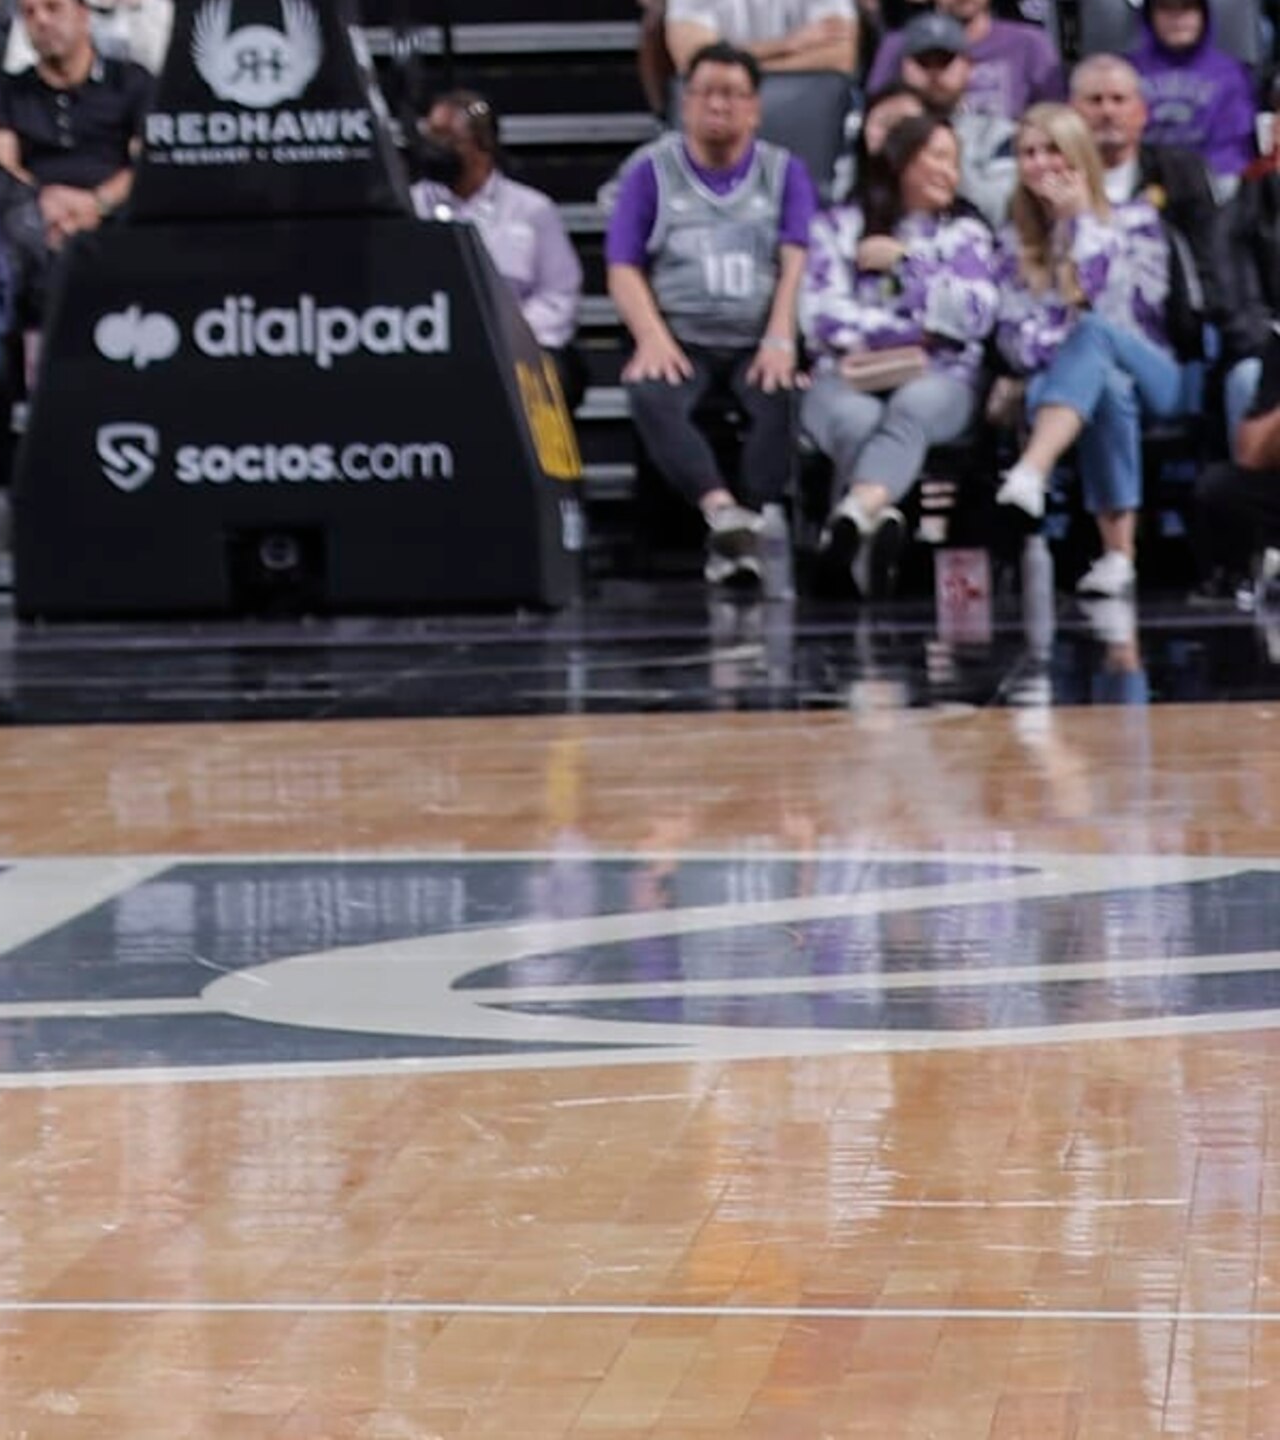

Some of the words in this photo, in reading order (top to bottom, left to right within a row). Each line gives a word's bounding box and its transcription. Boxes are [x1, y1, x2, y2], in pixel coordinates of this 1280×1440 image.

[144, 108, 372, 146] REDHAWK
[192, 291, 451, 370] dialpad
[174, 441, 454, 484] socios.com
